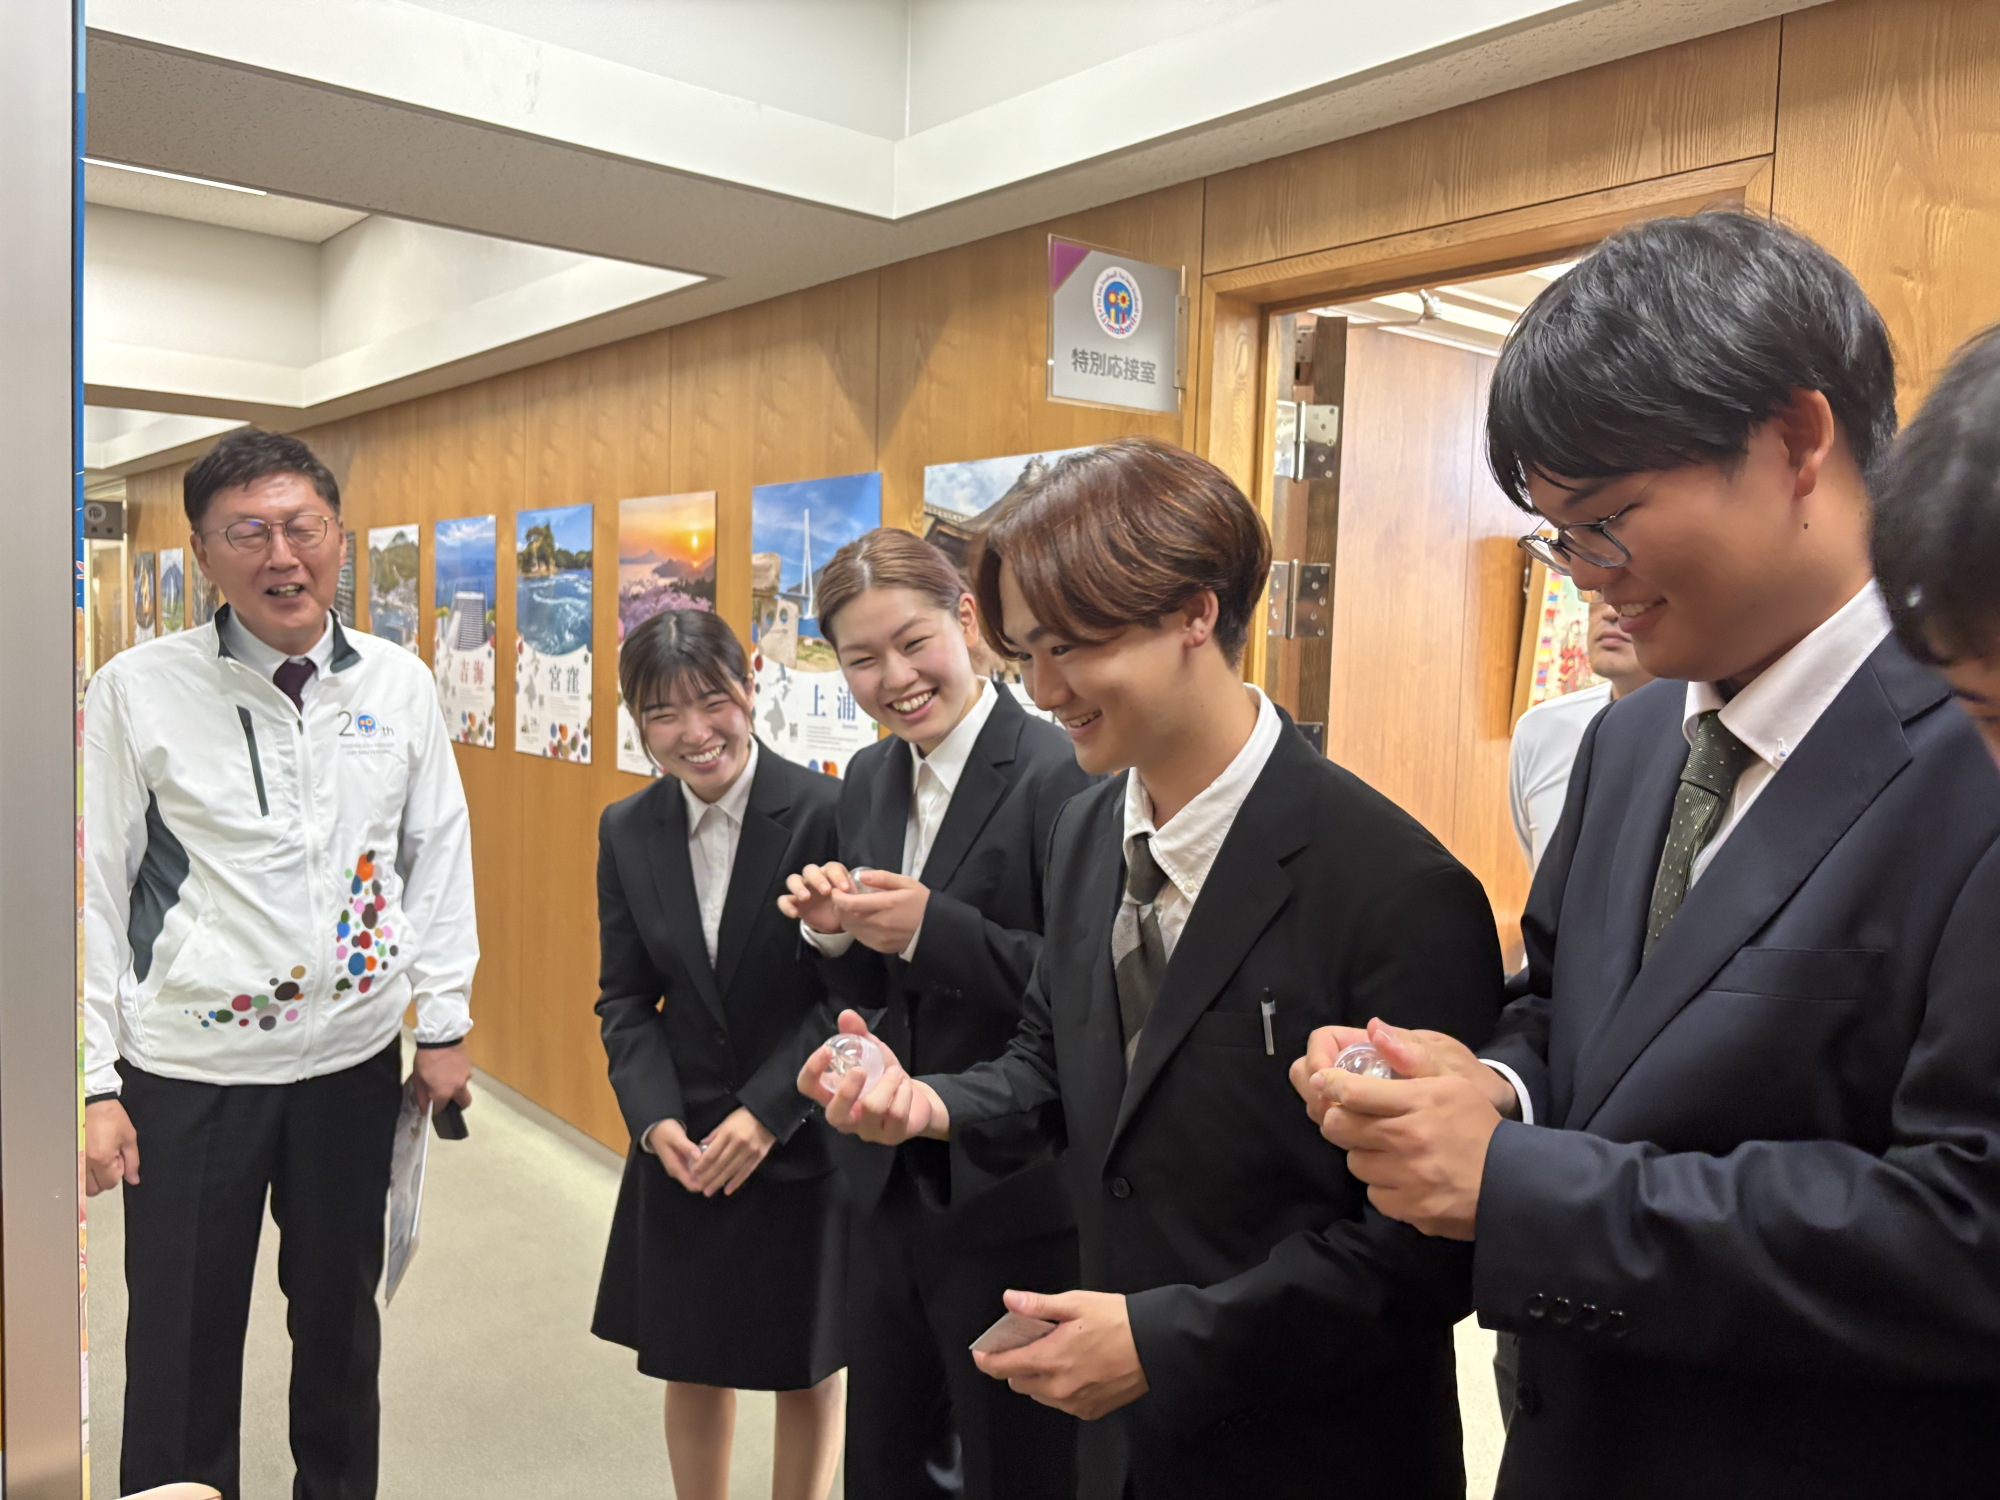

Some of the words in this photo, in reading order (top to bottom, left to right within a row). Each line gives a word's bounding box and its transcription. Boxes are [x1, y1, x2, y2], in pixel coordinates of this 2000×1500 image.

[1071, 347, 1156, 385] 特別応接室
[460, 658, 485, 685] 吉海
[549, 663, 580, 694] 宮窪
[806, 684, 857, 721] 上浦
